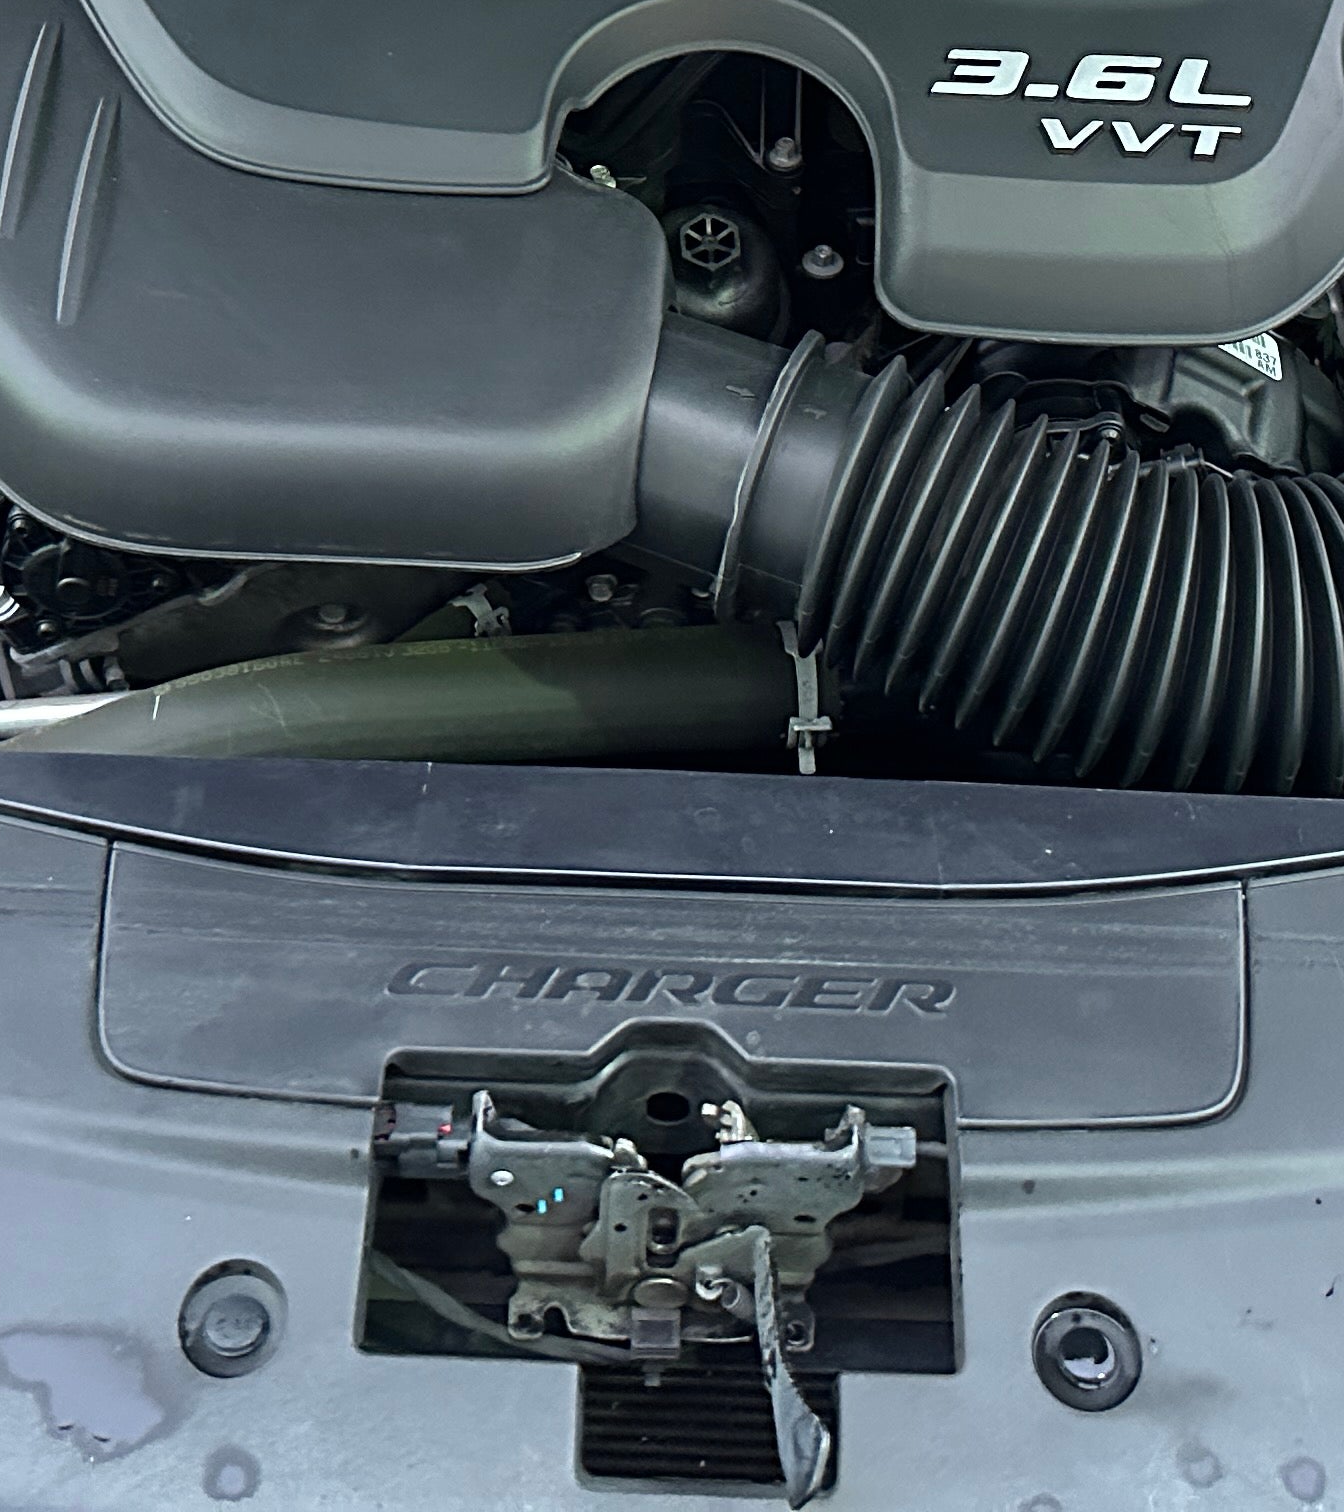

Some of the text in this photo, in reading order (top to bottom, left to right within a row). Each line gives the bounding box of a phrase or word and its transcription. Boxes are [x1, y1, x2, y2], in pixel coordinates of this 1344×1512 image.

[929, 46, 1253, 109] 3.6L
[1039, 116, 1243, 161] VVT
[384, 959, 958, 1017] CHARGER
